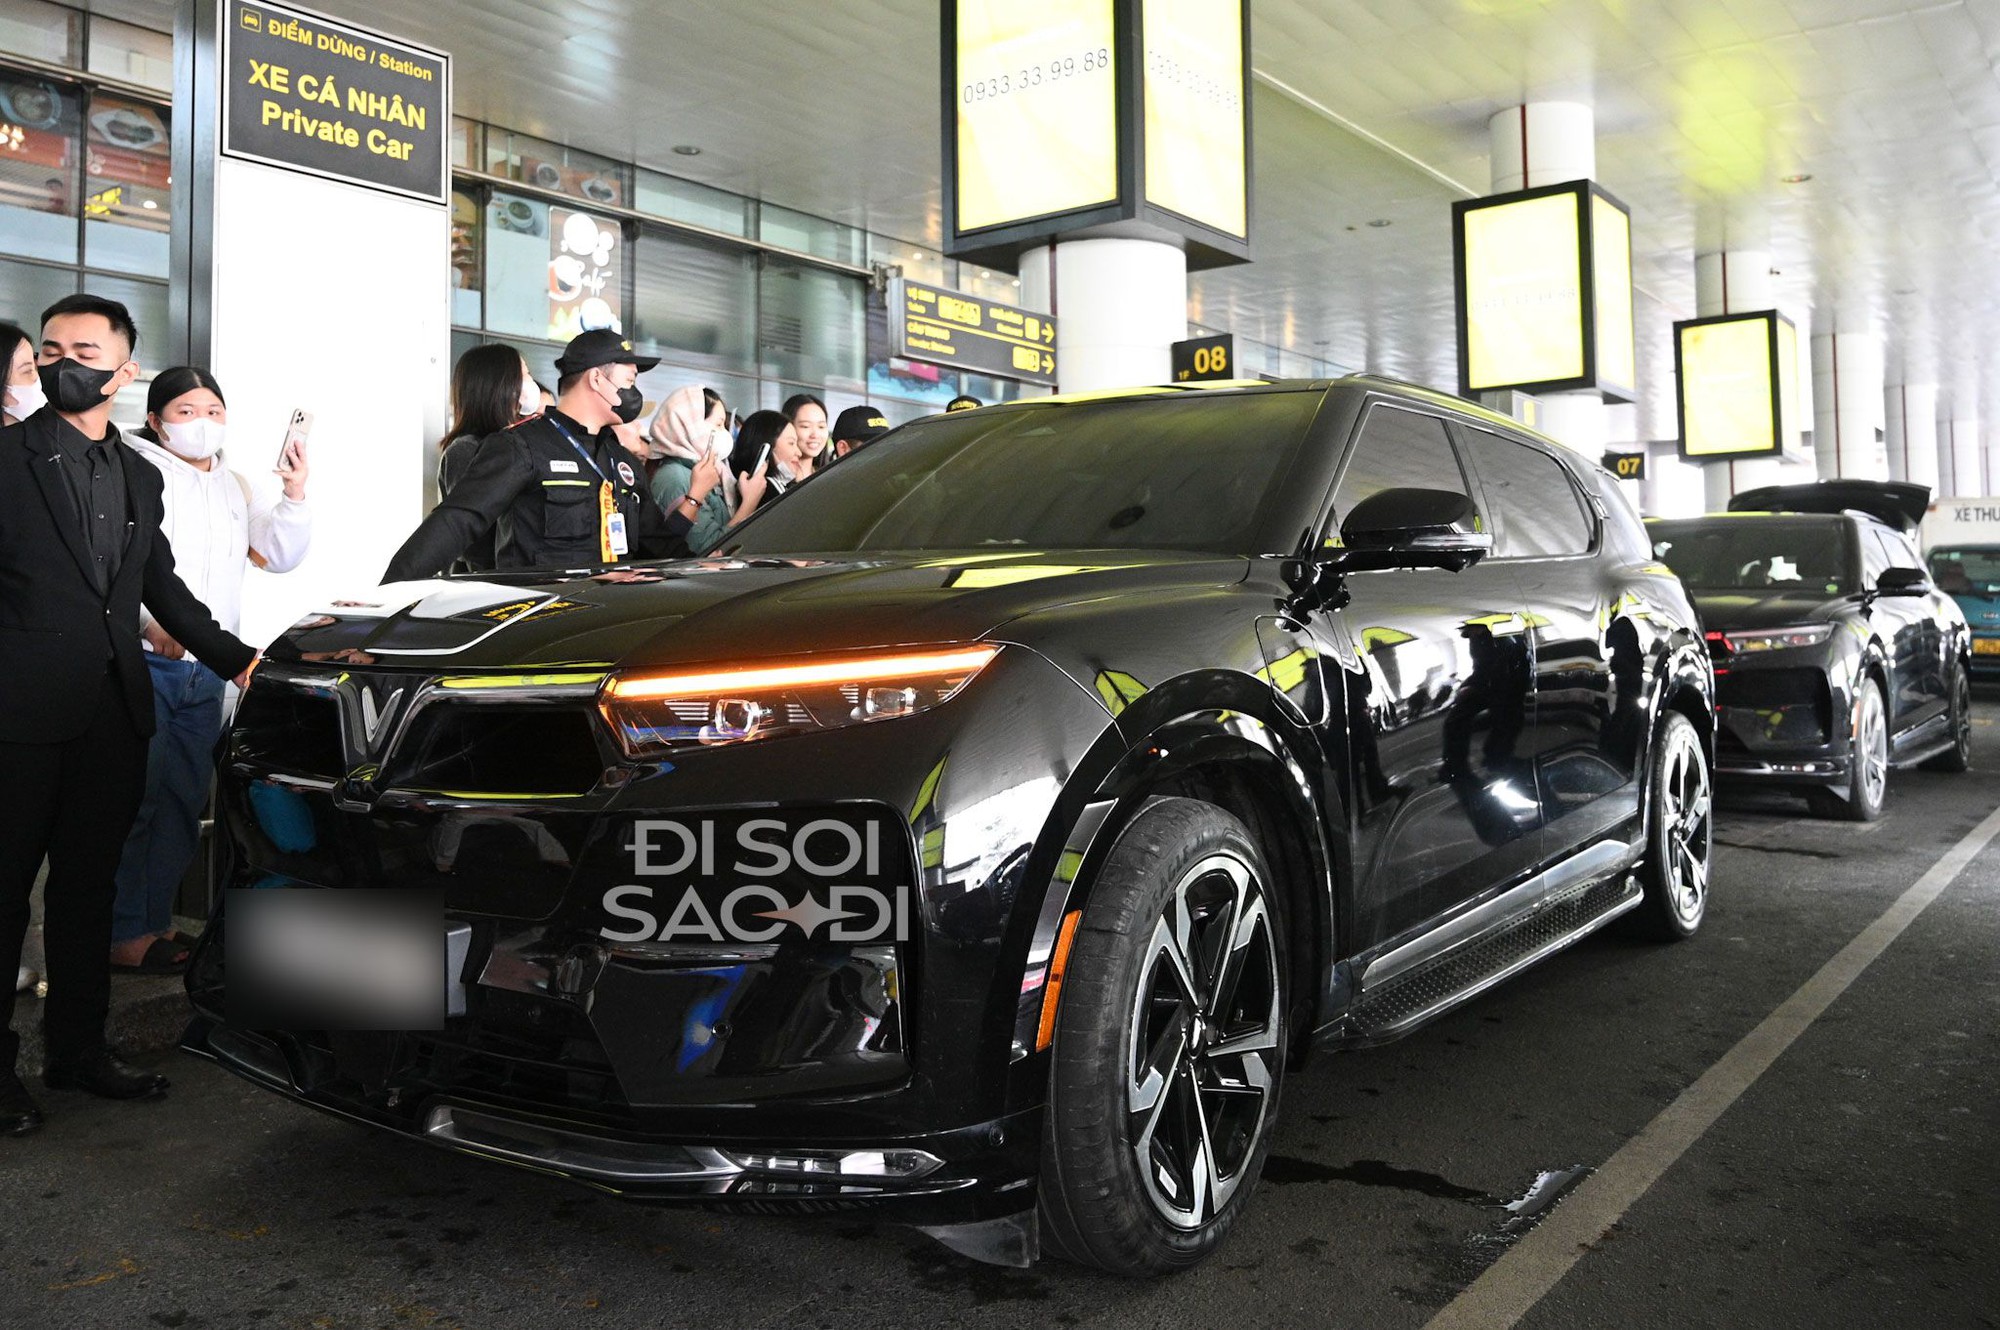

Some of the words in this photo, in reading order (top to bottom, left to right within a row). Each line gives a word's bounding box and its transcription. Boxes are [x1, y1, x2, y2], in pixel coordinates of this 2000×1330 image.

[268, 18, 313, 46] ĐIỂM
[317, 34, 366, 62] DỪNG
[369, 50, 376, 64] /
[379, 53, 432, 81] Station
[963, 48, 1109, 104] 0933.33.99.88
[248, 59, 290, 94] XE
[297, 74, 341, 108] CÁ
[347, 86, 426, 130] NHÂN
[261, 100, 359, 147] Private
[366, 128, 414, 161] Car
[1194, 345, 1227, 374] 08
[1617, 457, 1641, 475] 07
[1954, 508, 1970, 522] XE
